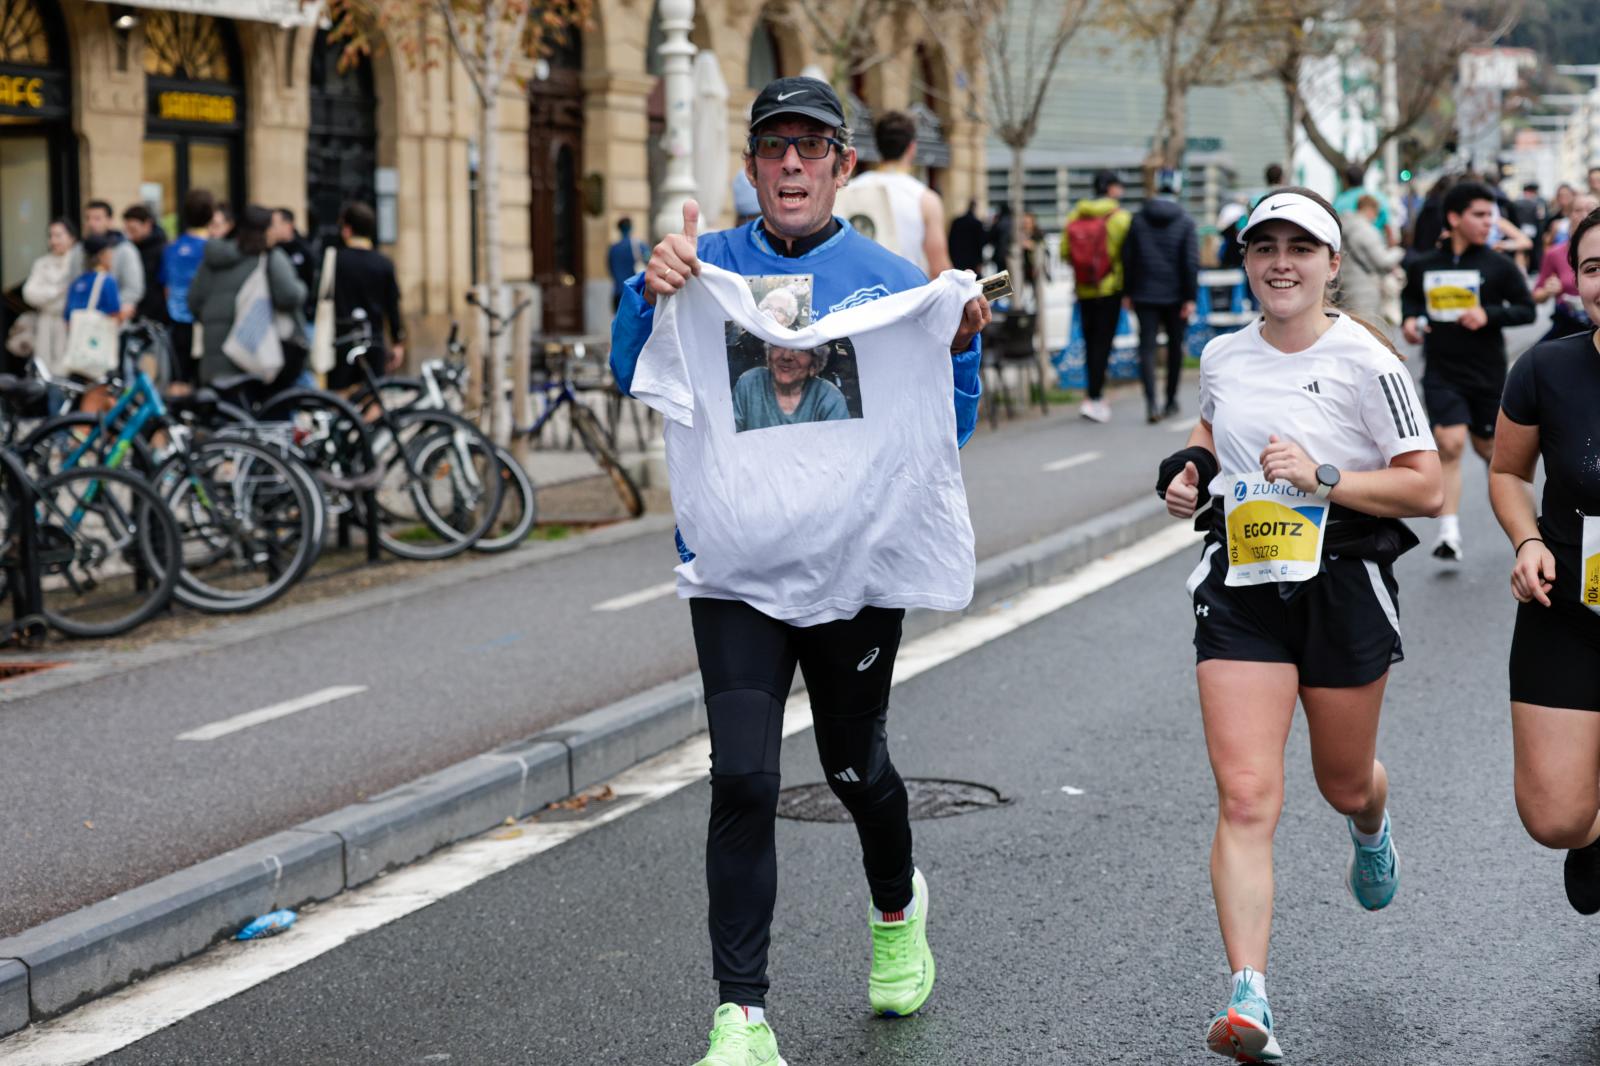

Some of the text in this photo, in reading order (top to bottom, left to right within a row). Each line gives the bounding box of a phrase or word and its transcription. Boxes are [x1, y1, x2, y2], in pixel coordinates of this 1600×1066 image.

[1253, 484, 1306, 498] ZURICH
[1244, 522, 1303, 538] EGOITZ
[1251, 545, 1278, 559] 13278
[1587, 586, 1599, 603] 10k
